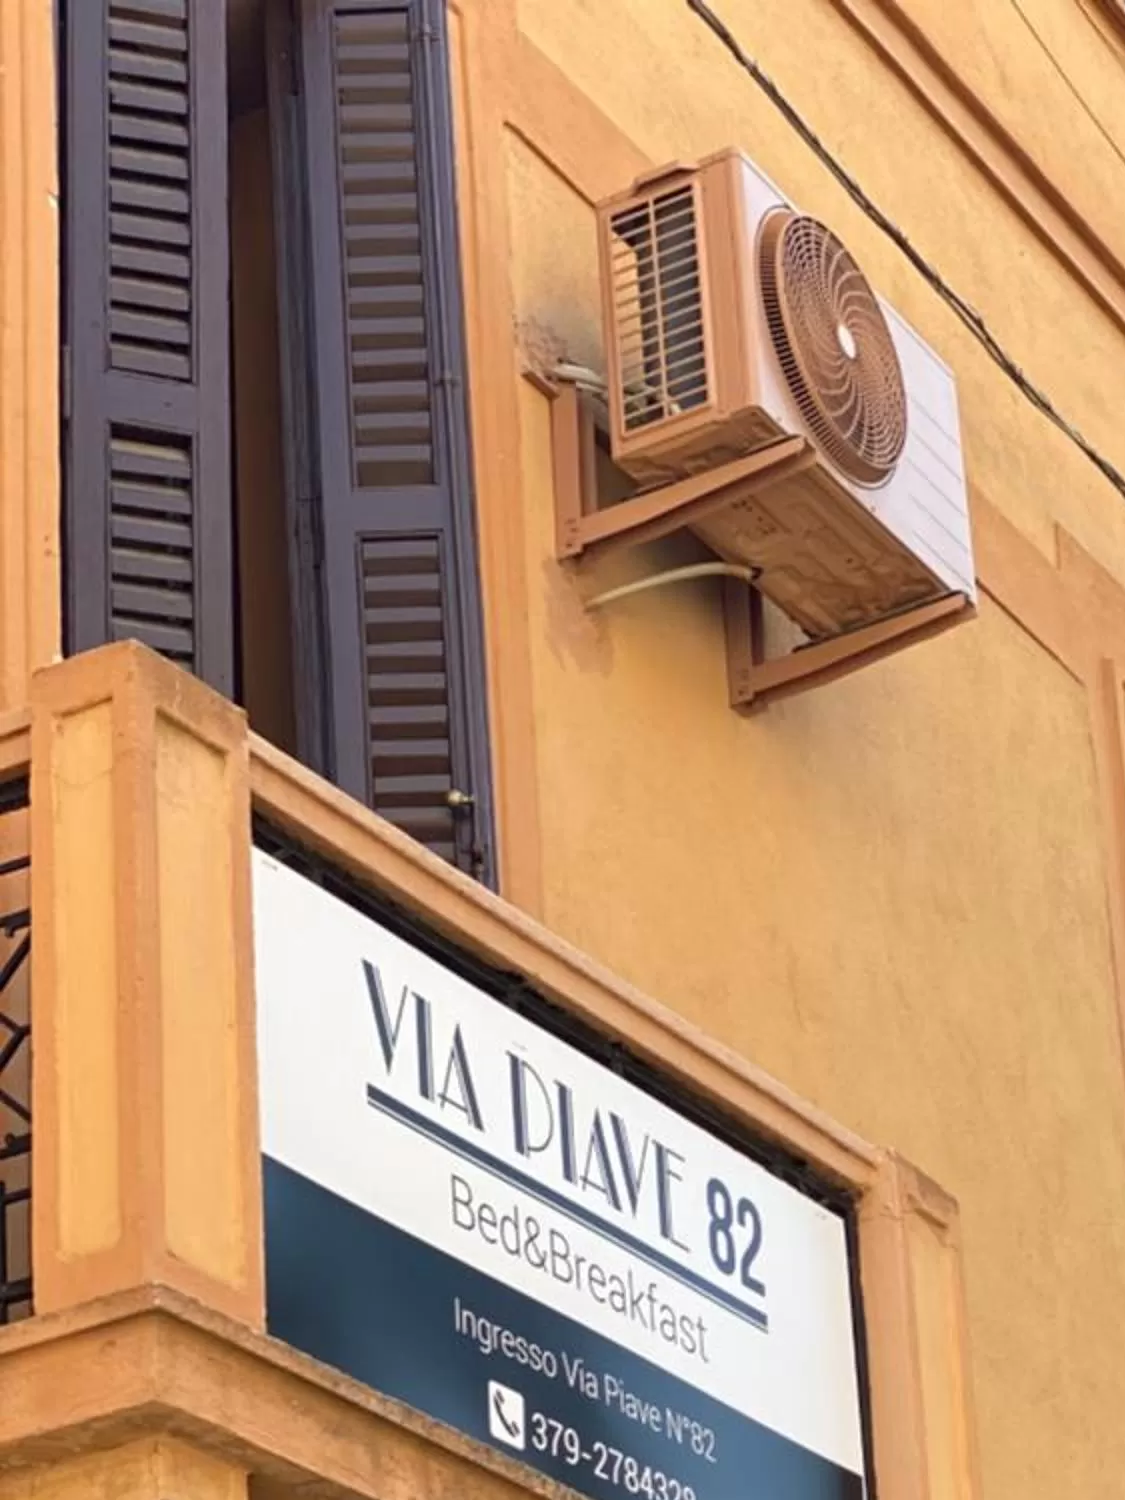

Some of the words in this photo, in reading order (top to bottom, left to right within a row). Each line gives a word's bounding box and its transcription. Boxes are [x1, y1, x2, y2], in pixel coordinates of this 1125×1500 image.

[361, 957, 486, 1133] VIA
[706, 1176, 767, 1298] 82
[450, 1173, 711, 1364] Bed&Breakfast
[453, 1296, 558, 1379] Ingresso
[560, 1350, 600, 1400] Via
[603, 1372, 663, 1433] Piave
